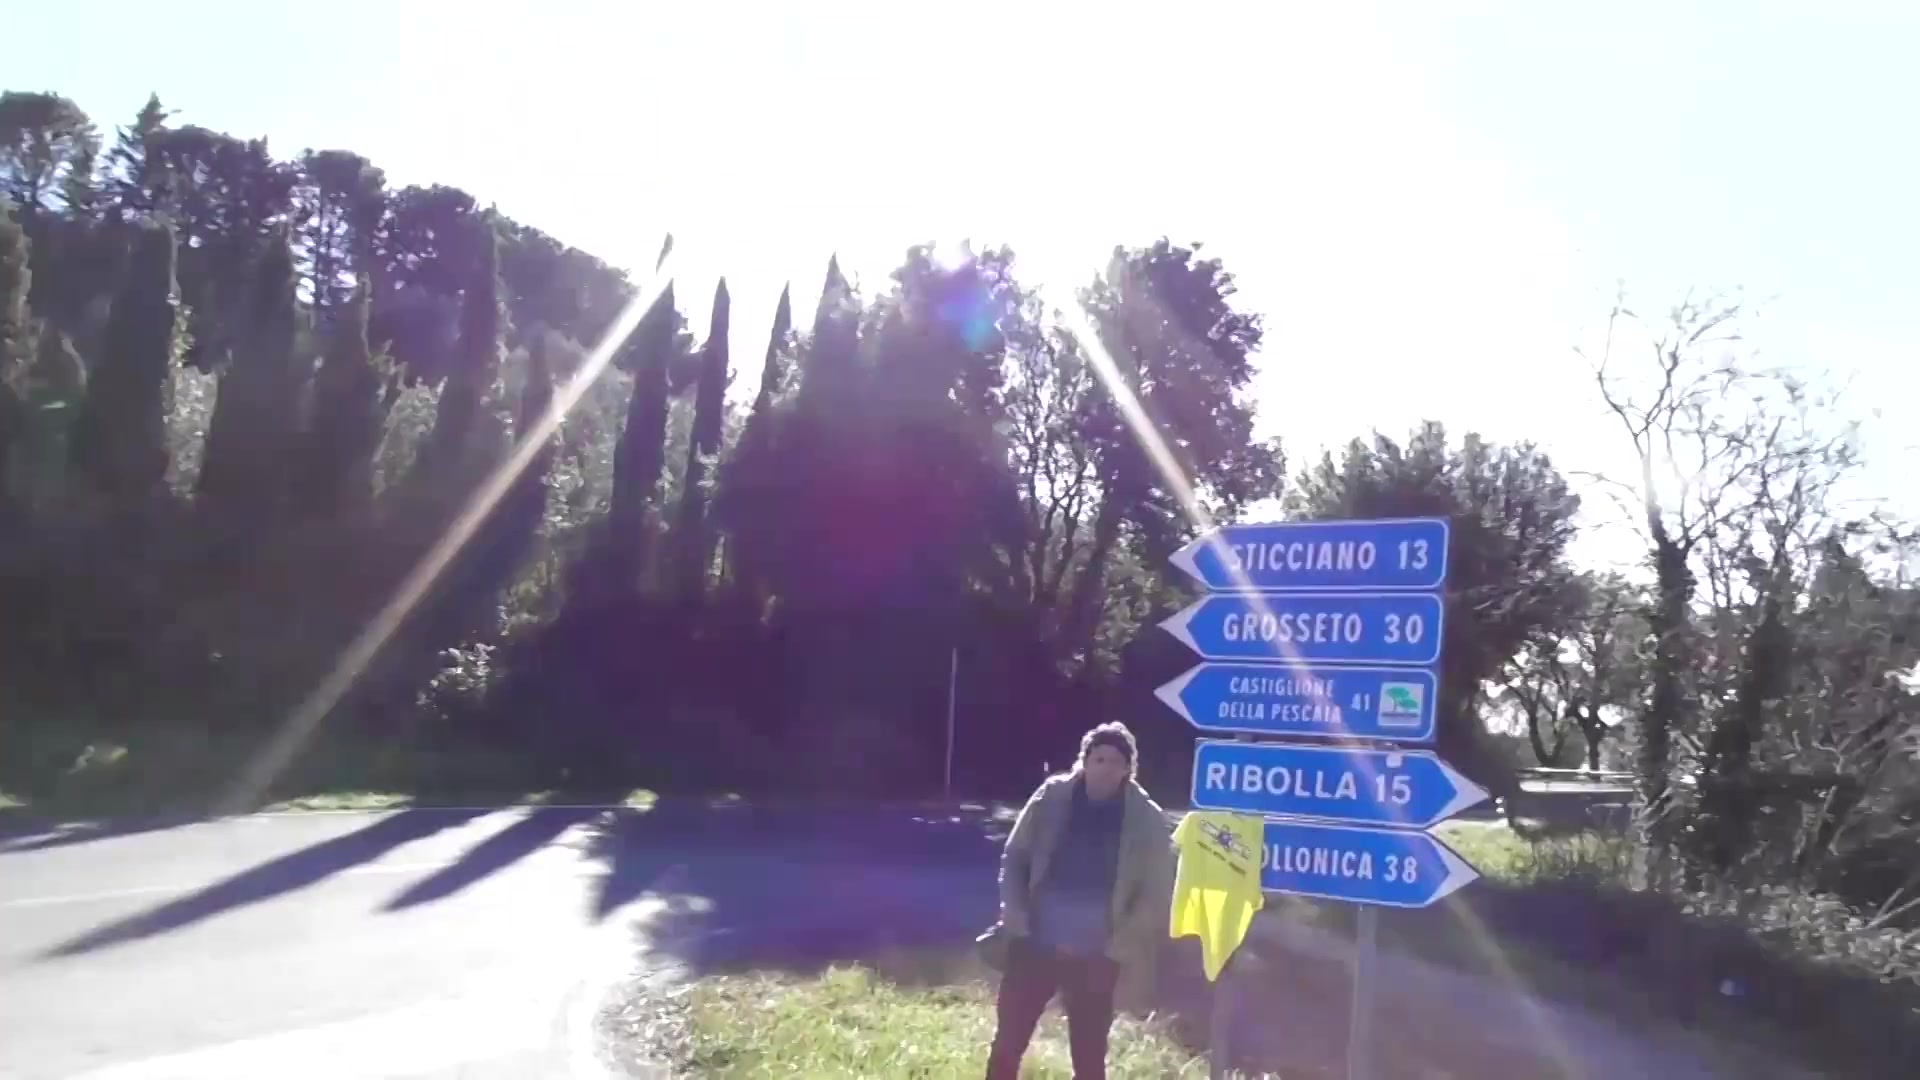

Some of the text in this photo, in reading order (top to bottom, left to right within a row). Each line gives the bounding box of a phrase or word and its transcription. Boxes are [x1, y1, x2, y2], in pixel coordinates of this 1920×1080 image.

[1229, 539, 1429, 571] STICCIANO 13
[1223, 612, 1423, 645] GROSSETO 30
[1229, 677, 1335, 698] CASTIGLIONE
[1351, 693, 1370, 711] 41
[1219, 701, 1341, 724] DELLA PESCAIA
[1205, 761, 1412, 805] RIBOLLA 15
[1261, 844, 1373, 881] OLLONICA
[1383, 855, 1418, 884] 38
